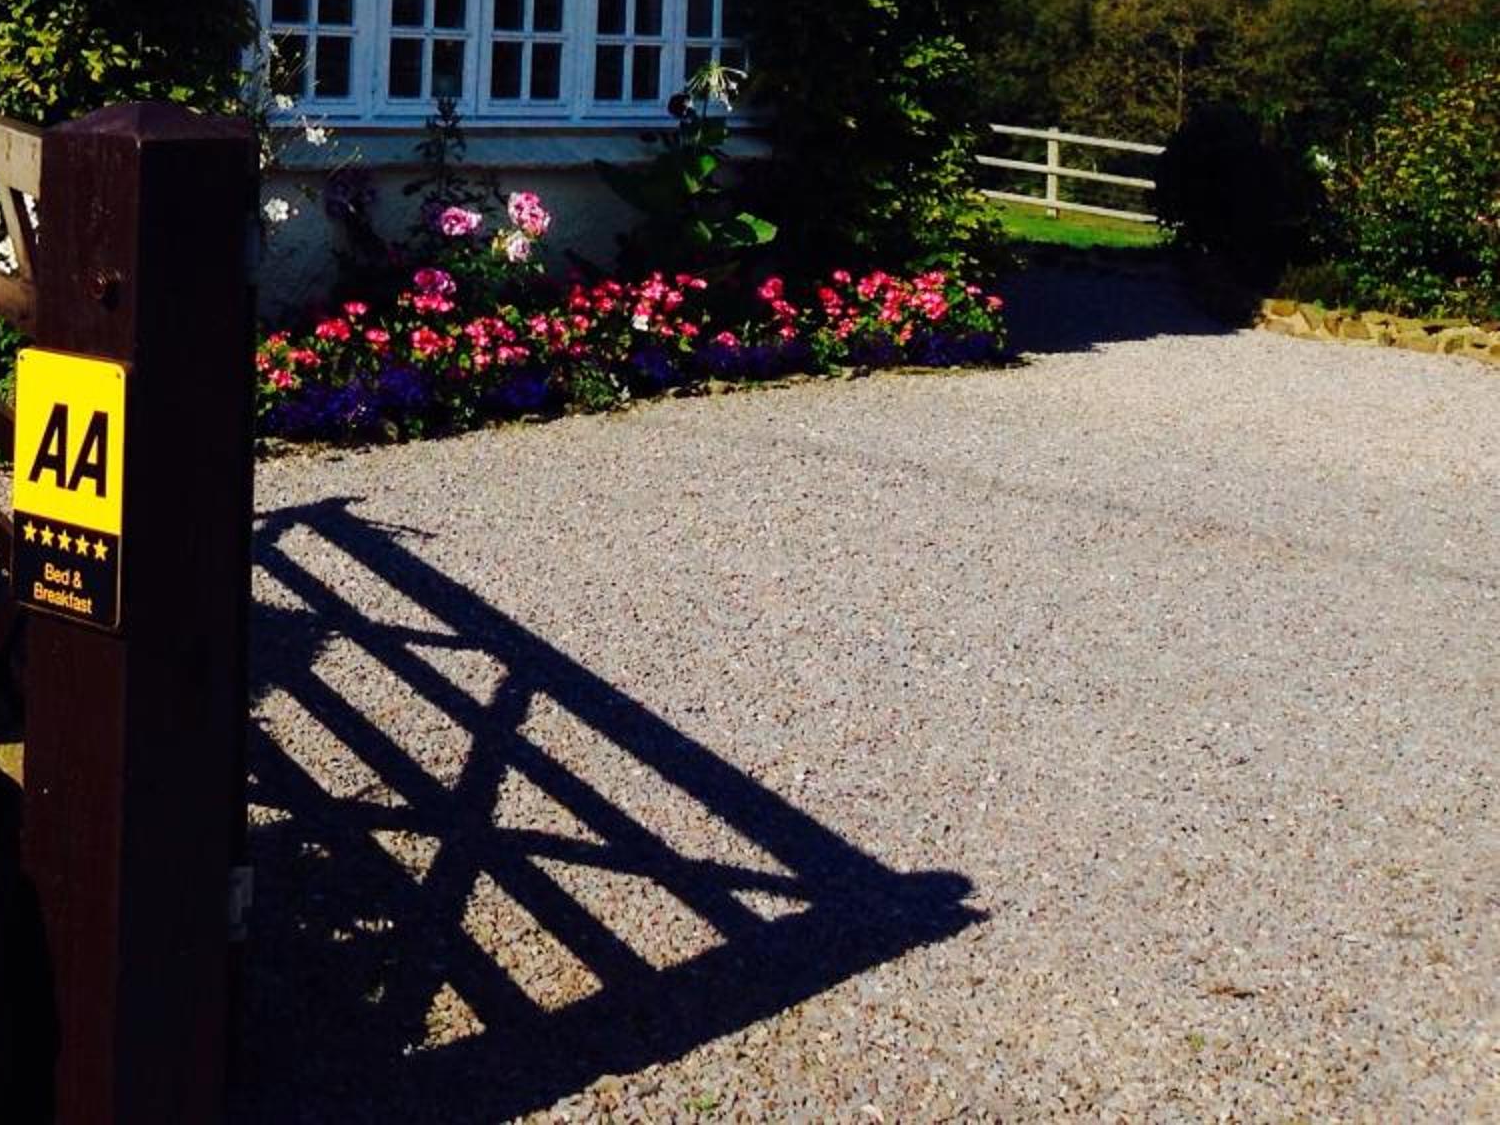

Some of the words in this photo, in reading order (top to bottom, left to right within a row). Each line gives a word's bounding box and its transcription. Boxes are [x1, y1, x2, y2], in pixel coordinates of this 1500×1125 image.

[28, 402, 108, 498] AA
[44, 562, 70, 586] Bed
[73, 570, 82, 589] &
[33, 581, 92, 614] Breakfast
